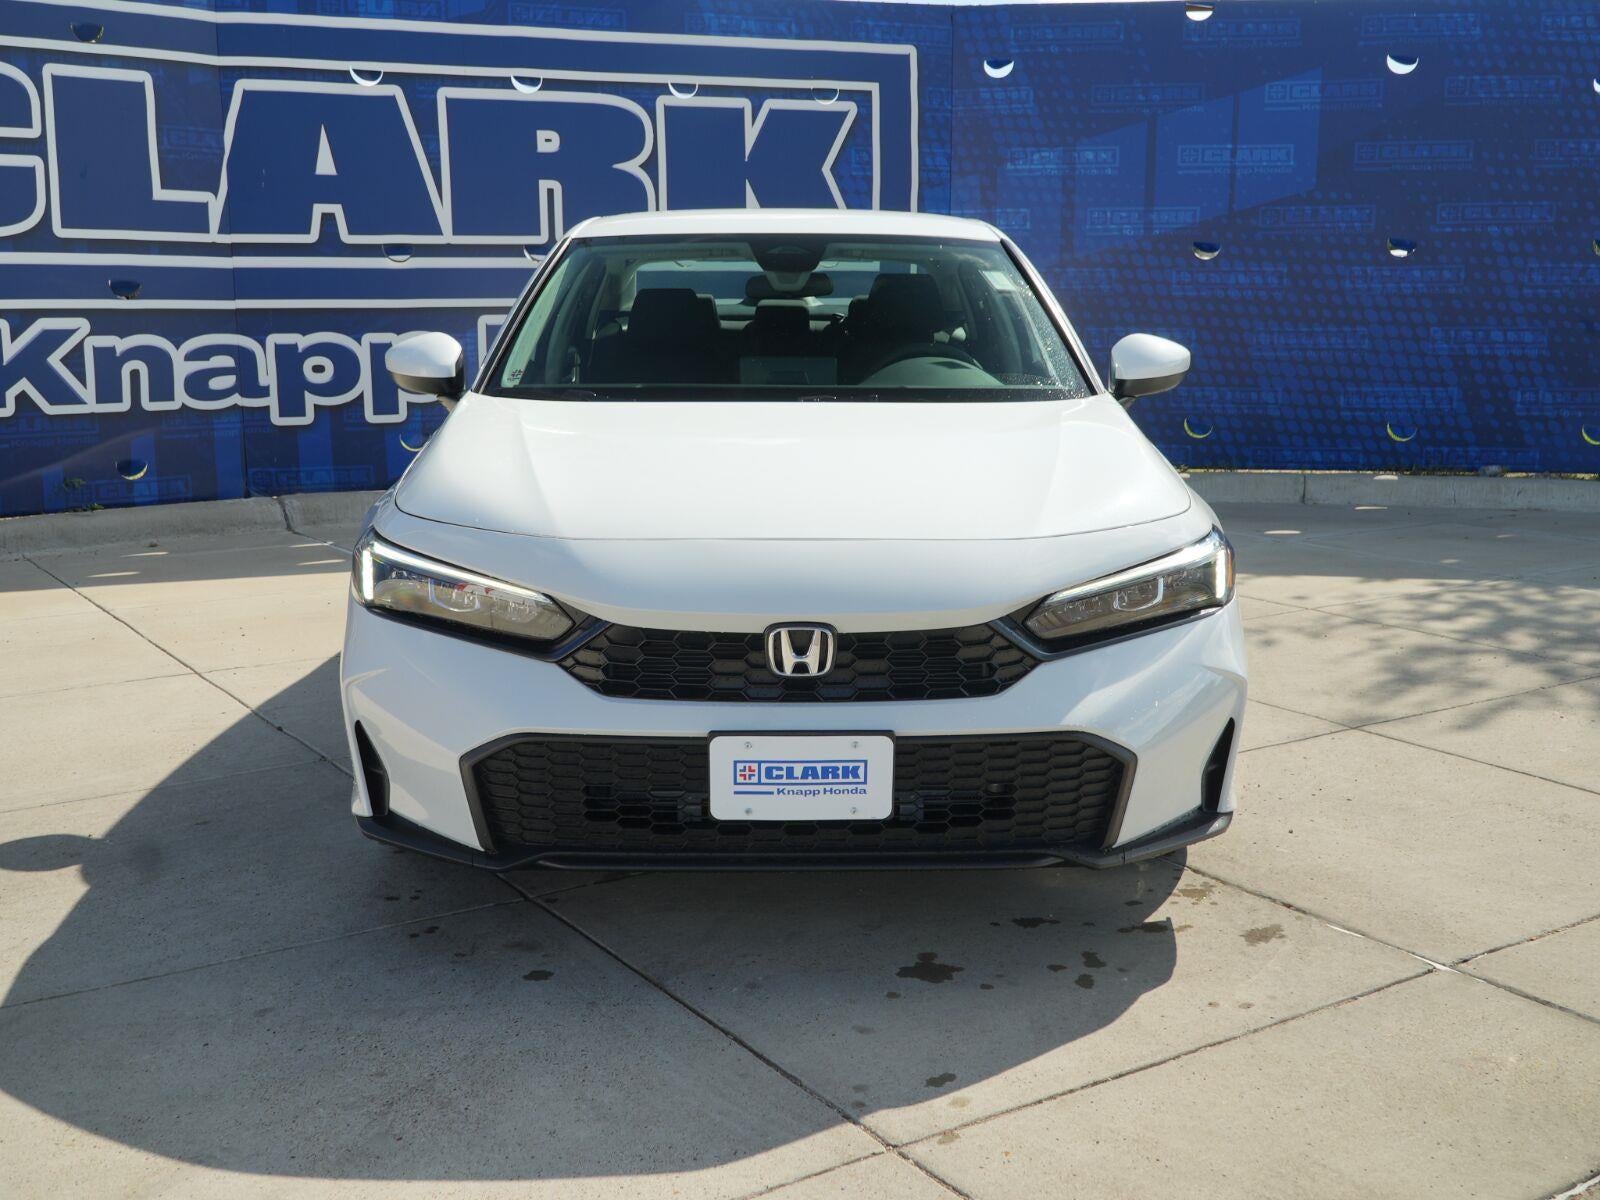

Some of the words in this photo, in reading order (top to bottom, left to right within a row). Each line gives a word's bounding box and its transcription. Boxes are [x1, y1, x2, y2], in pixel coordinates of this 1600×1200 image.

[764, 765, 861, 780] CLARK
[776, 788, 821, 797] Knapp
[823, 787, 867, 796] Honda
